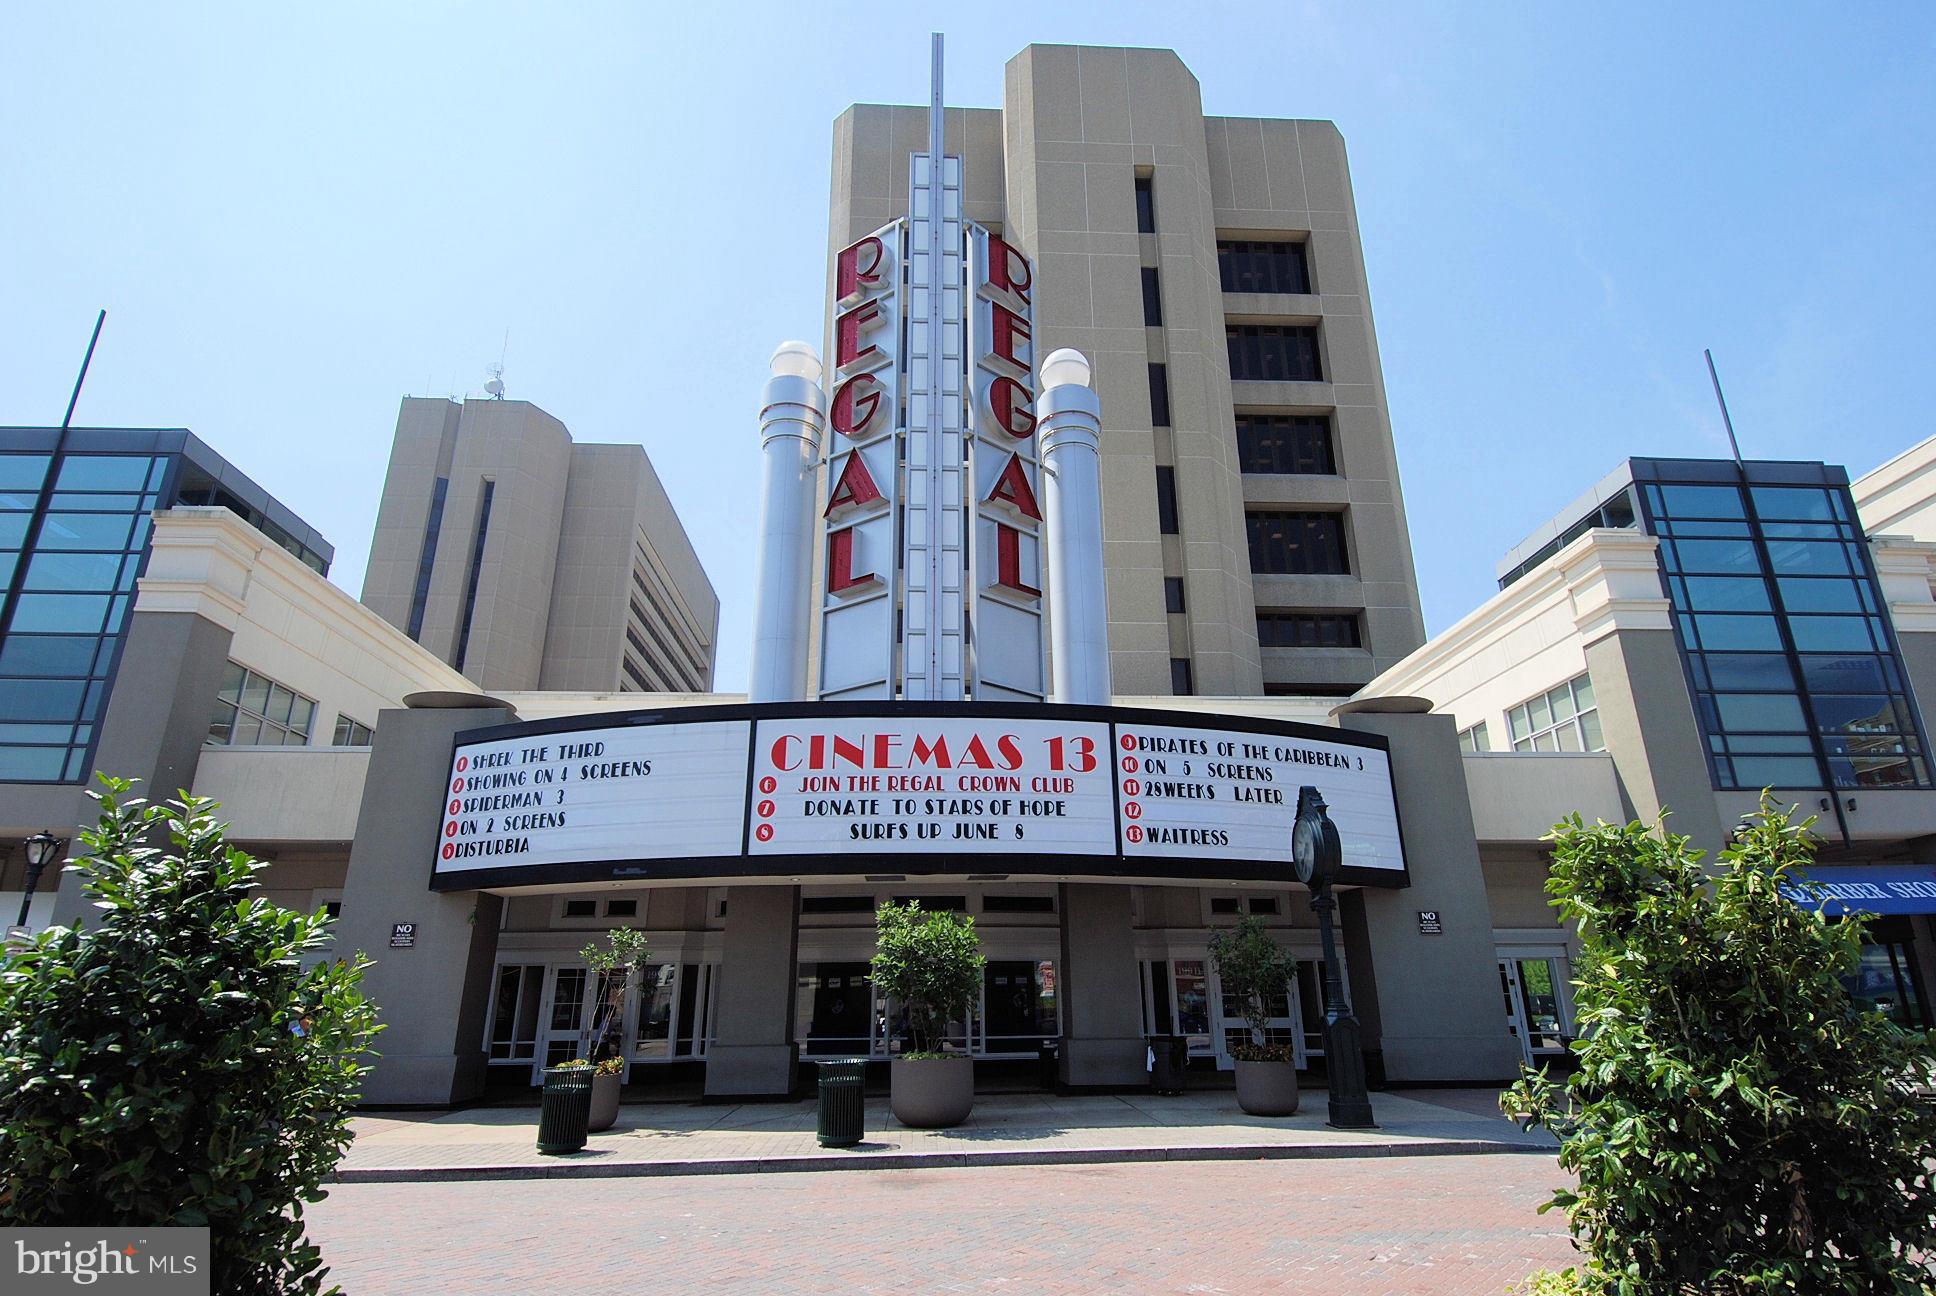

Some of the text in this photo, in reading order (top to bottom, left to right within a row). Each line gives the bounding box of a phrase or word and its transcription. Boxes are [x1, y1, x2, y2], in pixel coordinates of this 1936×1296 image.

[822, 236, 890, 599] REGAL
[982, 232, 1044, 599] REGAL
[472, 752, 513, 770] SHREK
[521, 746, 549, 764] THE
[558, 741, 605, 760] THIRD
[771, 733, 1097, 773] CINEMAS 13
[1139, 736, 1208, 755] PIRATES
[1217, 741, 1236, 757] OF
[1242, 743, 1270, 760] THE
[1274, 747, 1351, 770] CARIBBEAN
[1357, 756, 1365, 771] 3
[466, 771, 526, 792] SHOWING
[534, 767, 554, 785] ON
[560, 766, 568, 782] 4
[580, 760, 652, 780] SCREENS
[1144, 758, 1167, 775] ON
[1183, 760, 1191, 776] 5
[1207, 761, 1273, 782] SCREENS
[798, 775, 841, 793] JOIN
[841, 775, 881, 792] THE
[887, 775, 945, 792] REGAL
[958, 776, 1021, 793] CROWN
[1031, 776, 1075, 794] CLUB
[1234, 786, 1285, 805] LATER
[462, 791, 543, 814] SPIDERMAN
[556, 789, 565, 805] 3
[804, 799, 880, 817] DONATE
[893, 799, 918, 816] TO
[924, 799, 984, 816] STARS
[989, 799, 1013, 817] OF
[1019, 800, 1067, 817] HOPE
[460, 818, 478, 836] ON
[486, 818, 495, 834] 2
[503, 811, 566, 832] SCREENS
[849, 823, 909, 840] SURFS
[917, 823, 942, 840] UP
[951, 823, 1000, 840] JUNE
[1014, 823, 1025, 840] 8
[454, 837, 530, 858] DISTURBIA
[1146, 827, 1229, 846] WAITRESS
[396, 924, 413, 933] NO
[1421, 912, 1436, 921] NO
